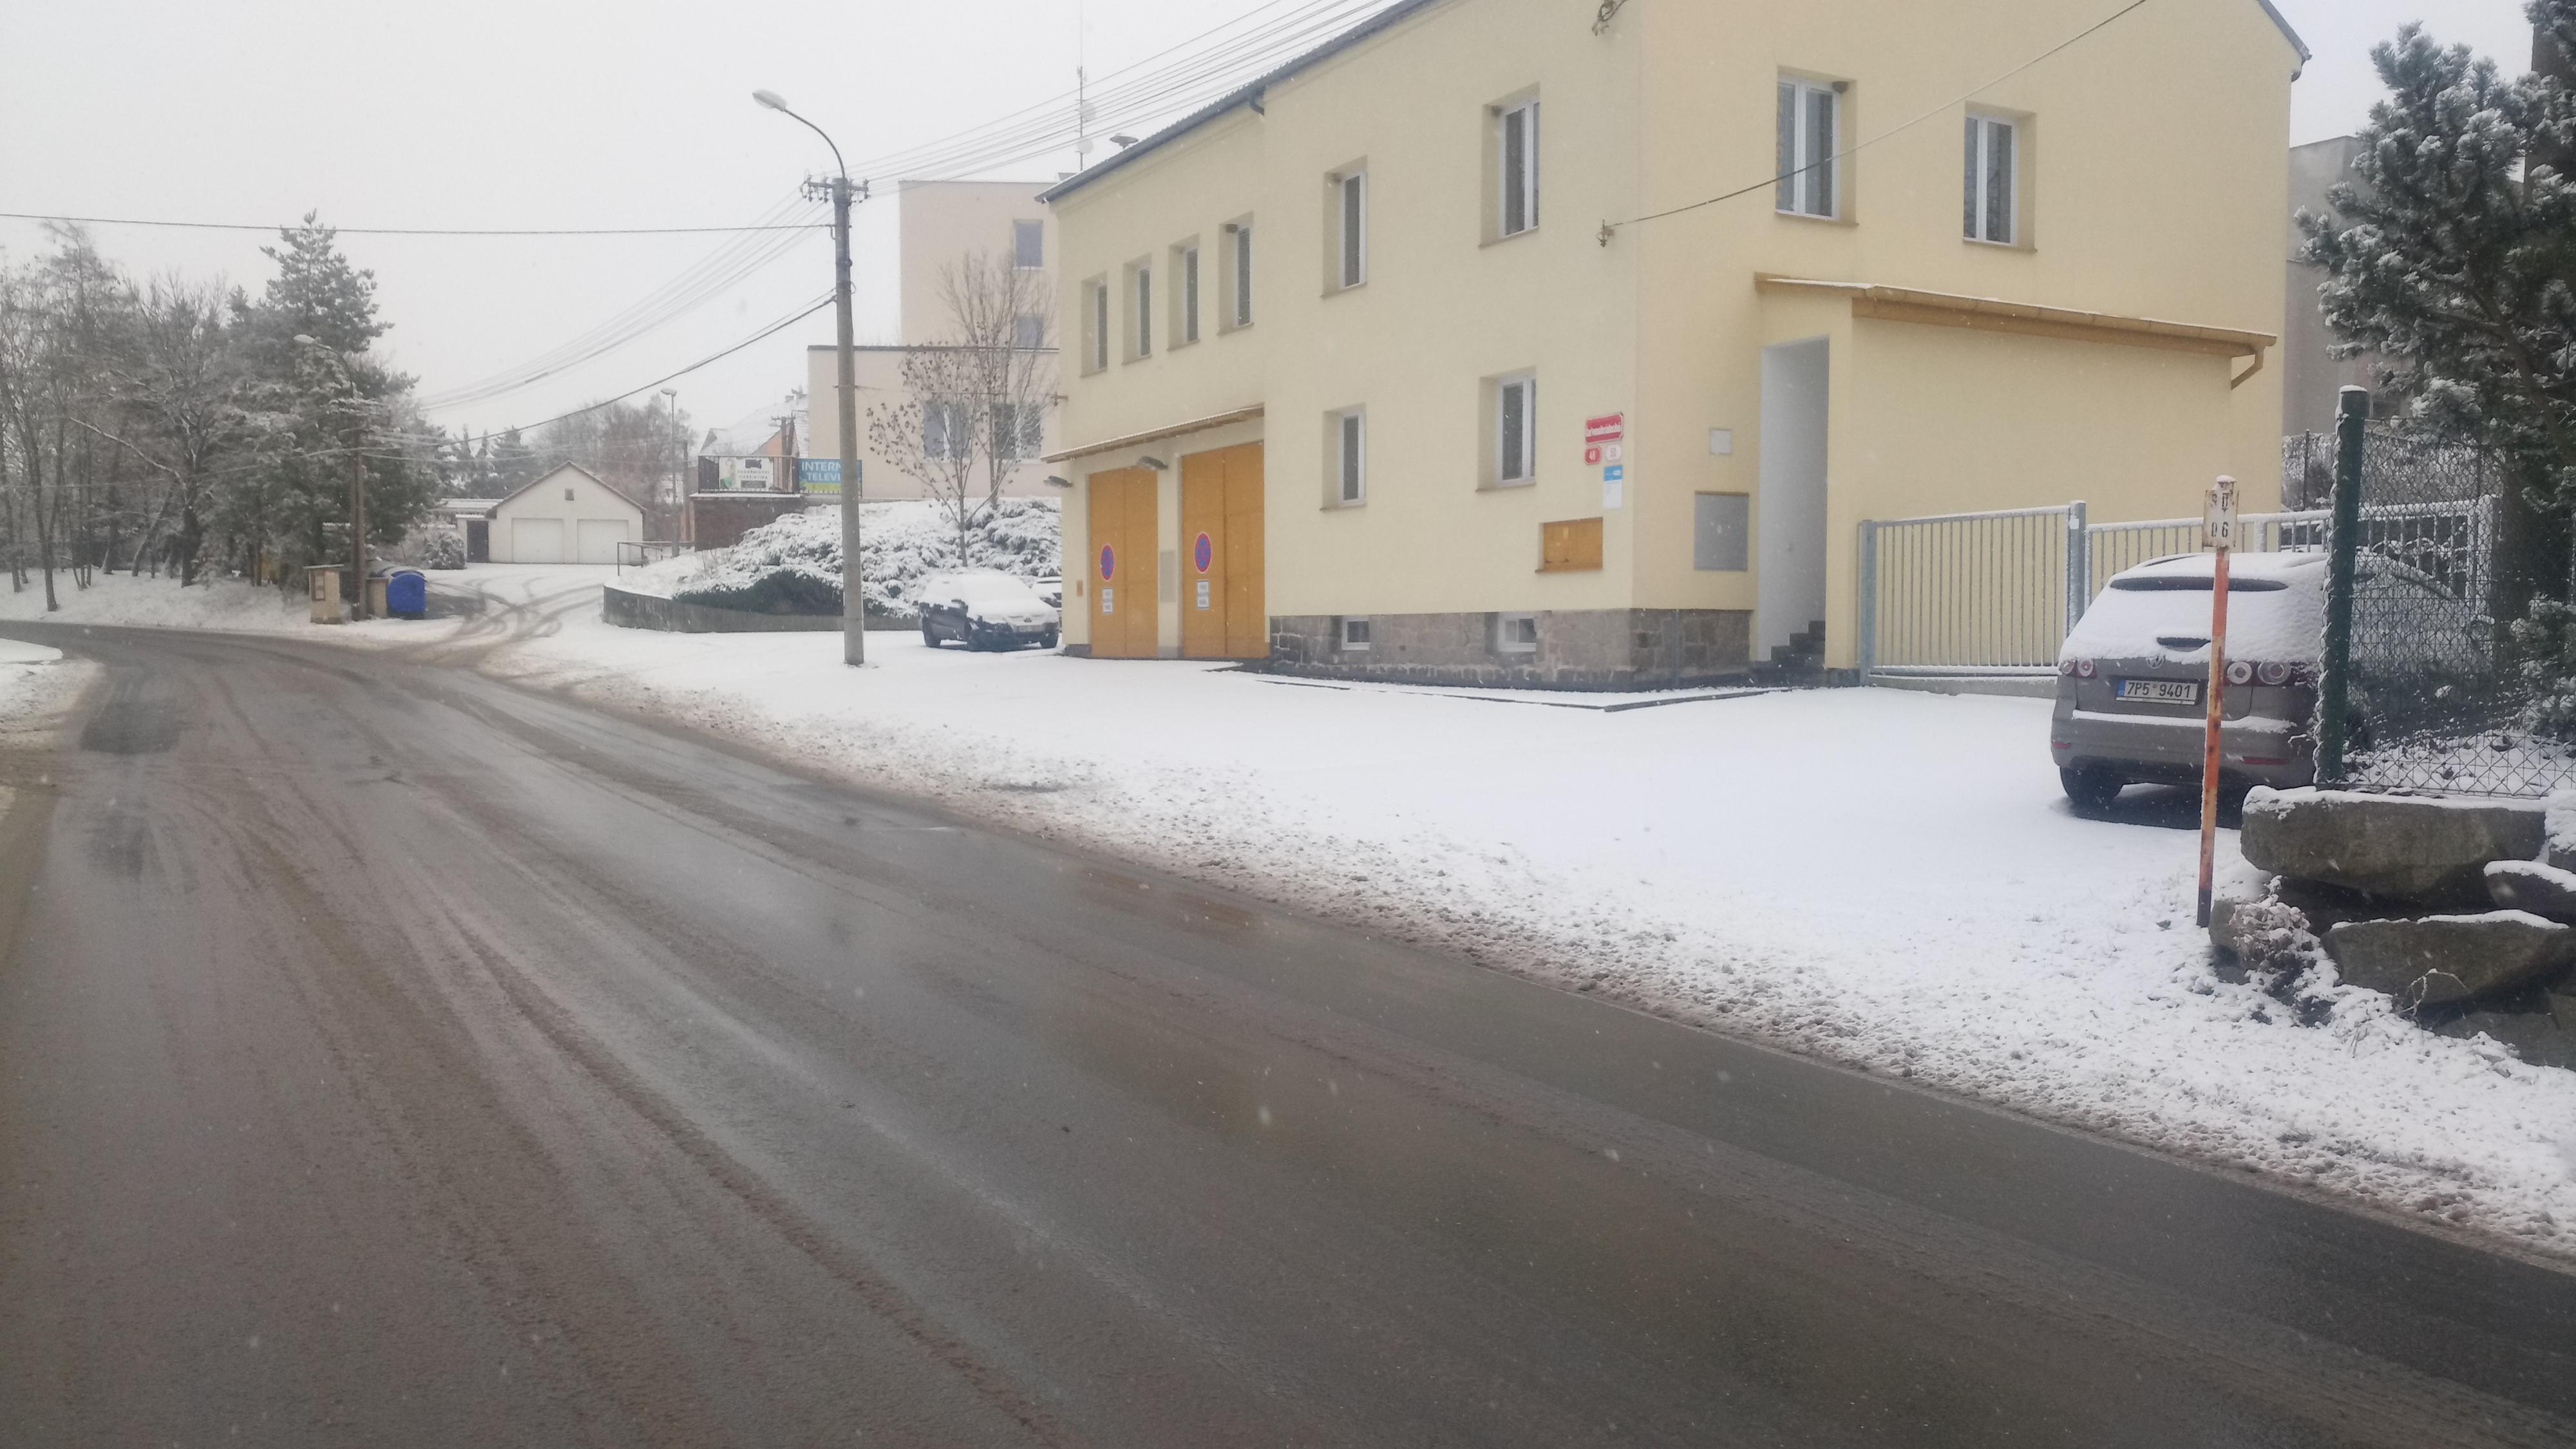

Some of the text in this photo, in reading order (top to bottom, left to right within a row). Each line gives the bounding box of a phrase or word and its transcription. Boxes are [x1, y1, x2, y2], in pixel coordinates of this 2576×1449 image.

[802, 461, 841, 471] INTERN
[806, 472, 840, 482] TELEVI
[2127, 682, 2150, 696] 7P5
[2159, 684, 2190, 698] 9401
